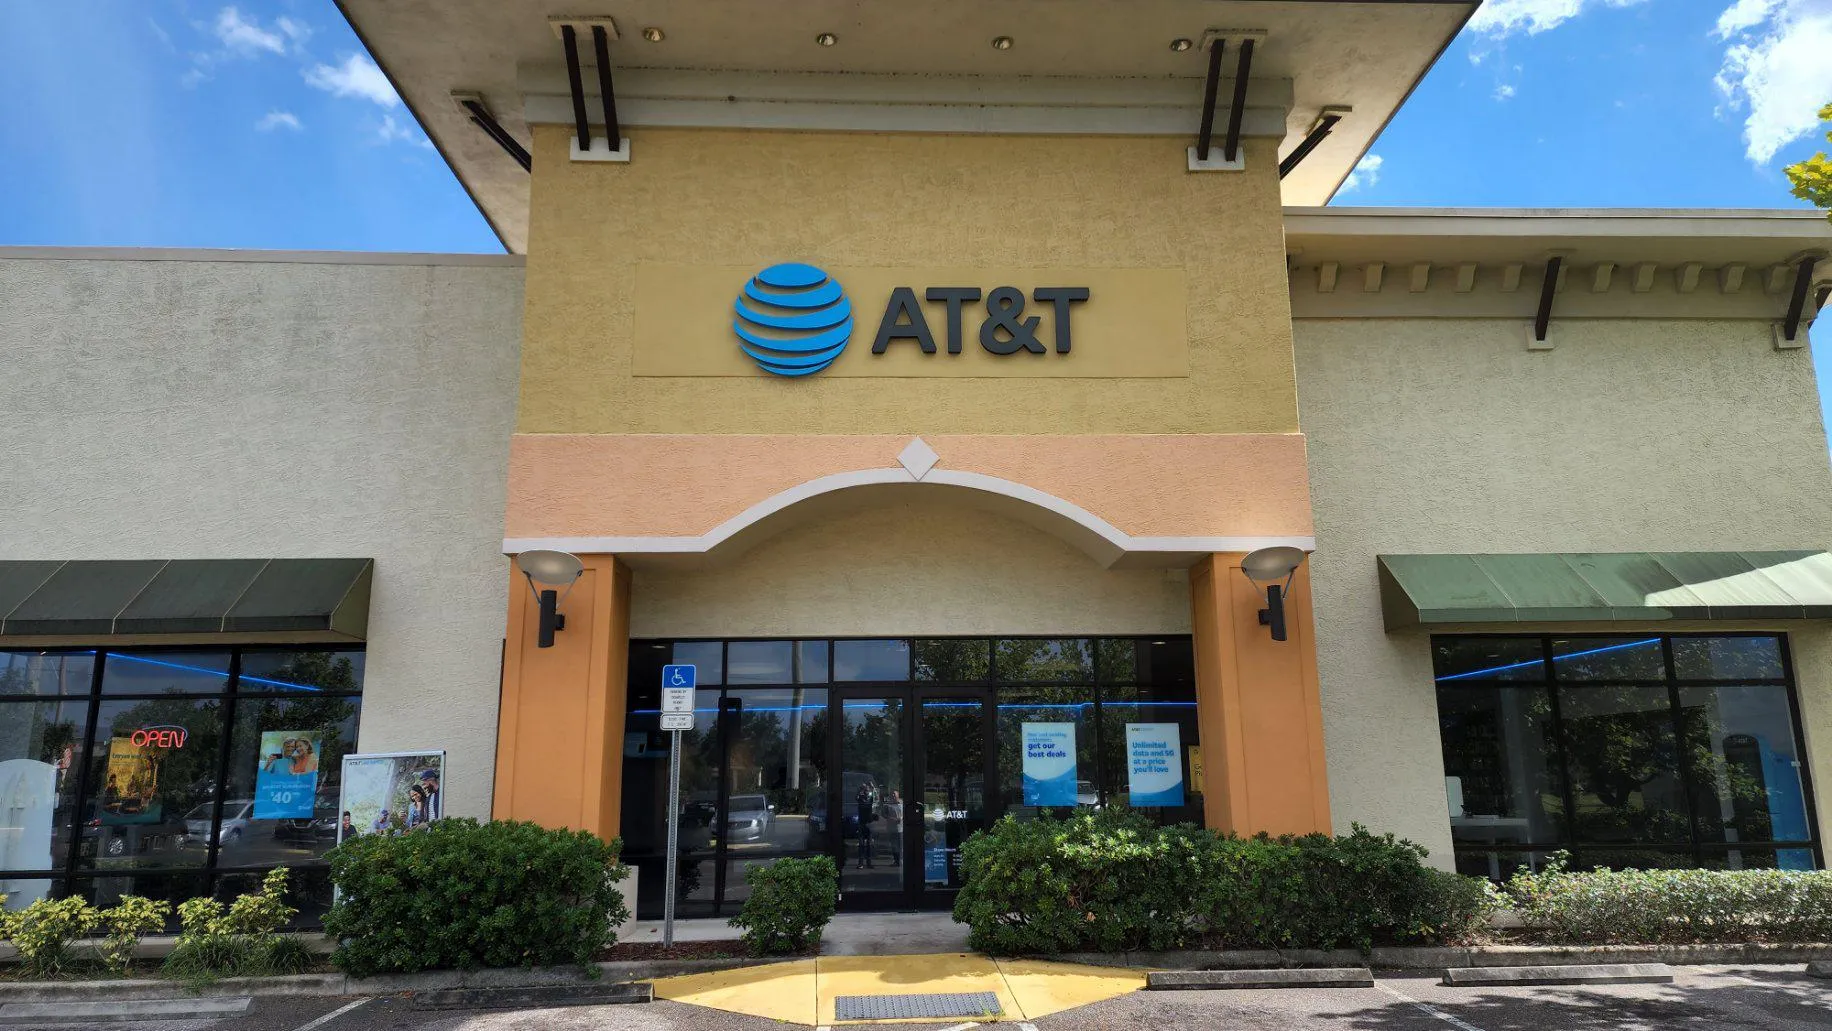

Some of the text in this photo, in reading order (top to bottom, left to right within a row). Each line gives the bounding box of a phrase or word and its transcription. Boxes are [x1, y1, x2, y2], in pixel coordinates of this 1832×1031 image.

[871, 286, 1090, 355] AT&T
[131, 730, 185, 748] OPEN
[1027, 742, 1041, 750] get
[1132, 741, 1167, 749] Unlimited
[1148, 758, 1166, 767] price
[1133, 766, 1153, 775] you'll
[946, 810, 968, 819] AT&T
